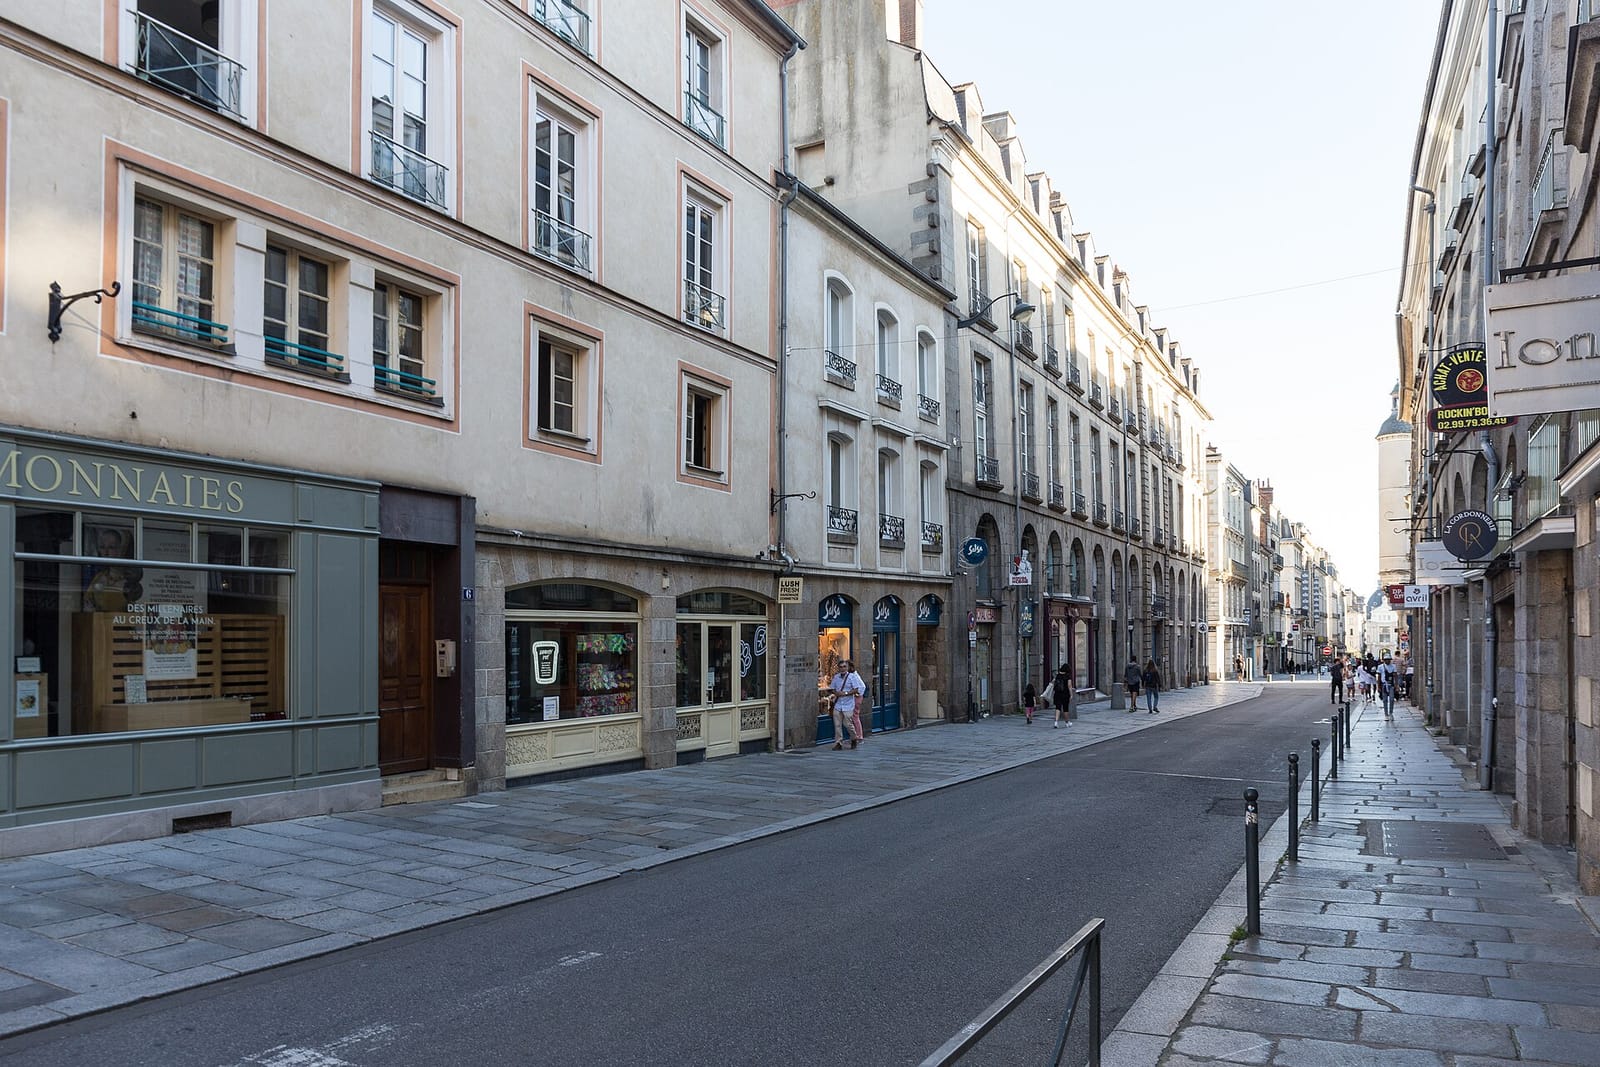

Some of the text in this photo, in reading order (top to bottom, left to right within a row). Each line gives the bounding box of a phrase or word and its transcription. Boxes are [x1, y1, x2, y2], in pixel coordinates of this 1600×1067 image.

[1444, 511, 1496, 534] LA CORDONNERIE
[465, 589, 472, 599] 6
[1406, 594, 1428, 602] avril
[127, 603, 145, 613] DES
[112, 616, 126, 624] AU
[129, 616, 161, 624] CREUX
[163, 616, 175, 624] DE
